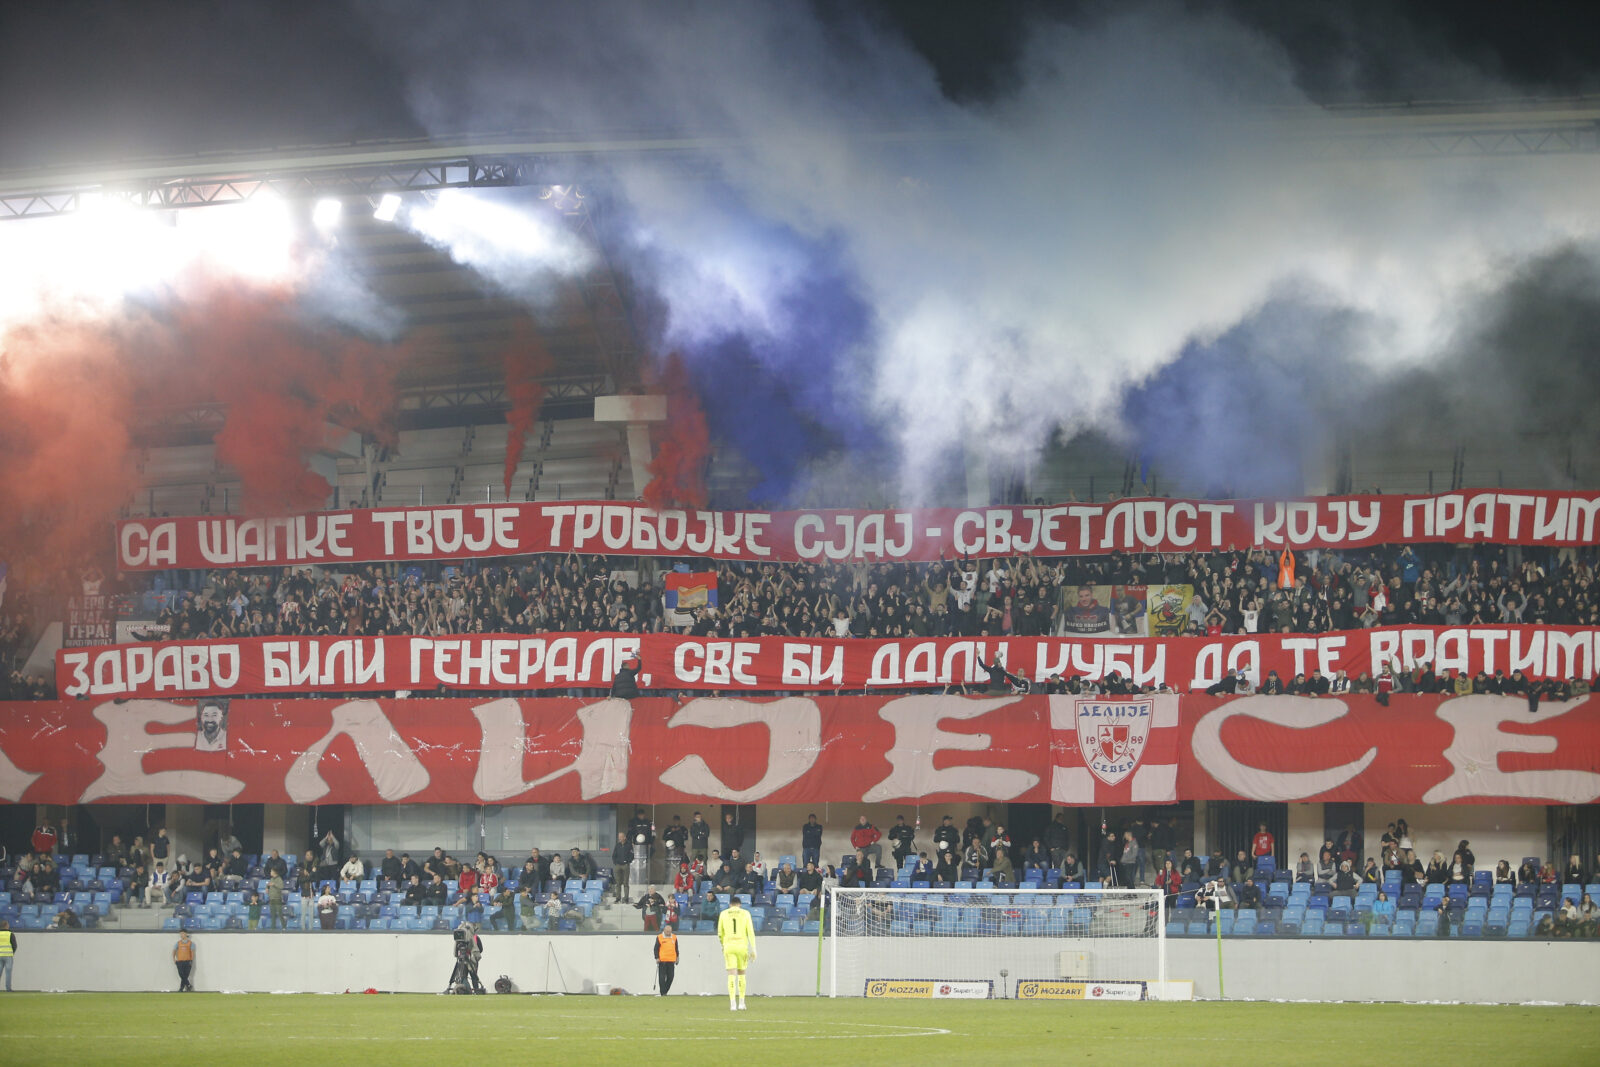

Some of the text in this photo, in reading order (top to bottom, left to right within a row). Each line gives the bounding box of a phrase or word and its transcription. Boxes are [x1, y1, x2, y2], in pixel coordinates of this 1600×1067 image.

[121, 522, 177, 566] СА
[199, 514, 354, 564] ШАПКЕ
[372, 507, 520, 556] ТВОЈЕ
[541, 504, 772, 556] ТРОБОЈКЕ
[794, 512, 913, 561] СЈАЈ
[953, 501, 1235, 556] СВЈЕТЛОСТ
[1254, 500, 1381, 546] КОЈУ
[63, 643, 241, 697] ЗДРАВО
[262, 637, 385, 687] БИЛИ
[673, 641, 761, 686] СВЕ
[781, 642, 844, 686] БИ
[1190, 639, 1261, 690] ДА
[1281, 635, 1347, 682] ТЕ
[1369, 628, 1600, 678] ВРАТИМ
[1079, 705, 1150, 717] ДЕЛИЈЕ
[0, 697, 1040, 804] ЕЛИЈЕ
[1093, 761, 1134, 773] СЕВЕР
[732, 918, 737, 934] 1
[889, 986, 930, 994] MOZZART
[1040, 987, 1082, 995] MOZZART
